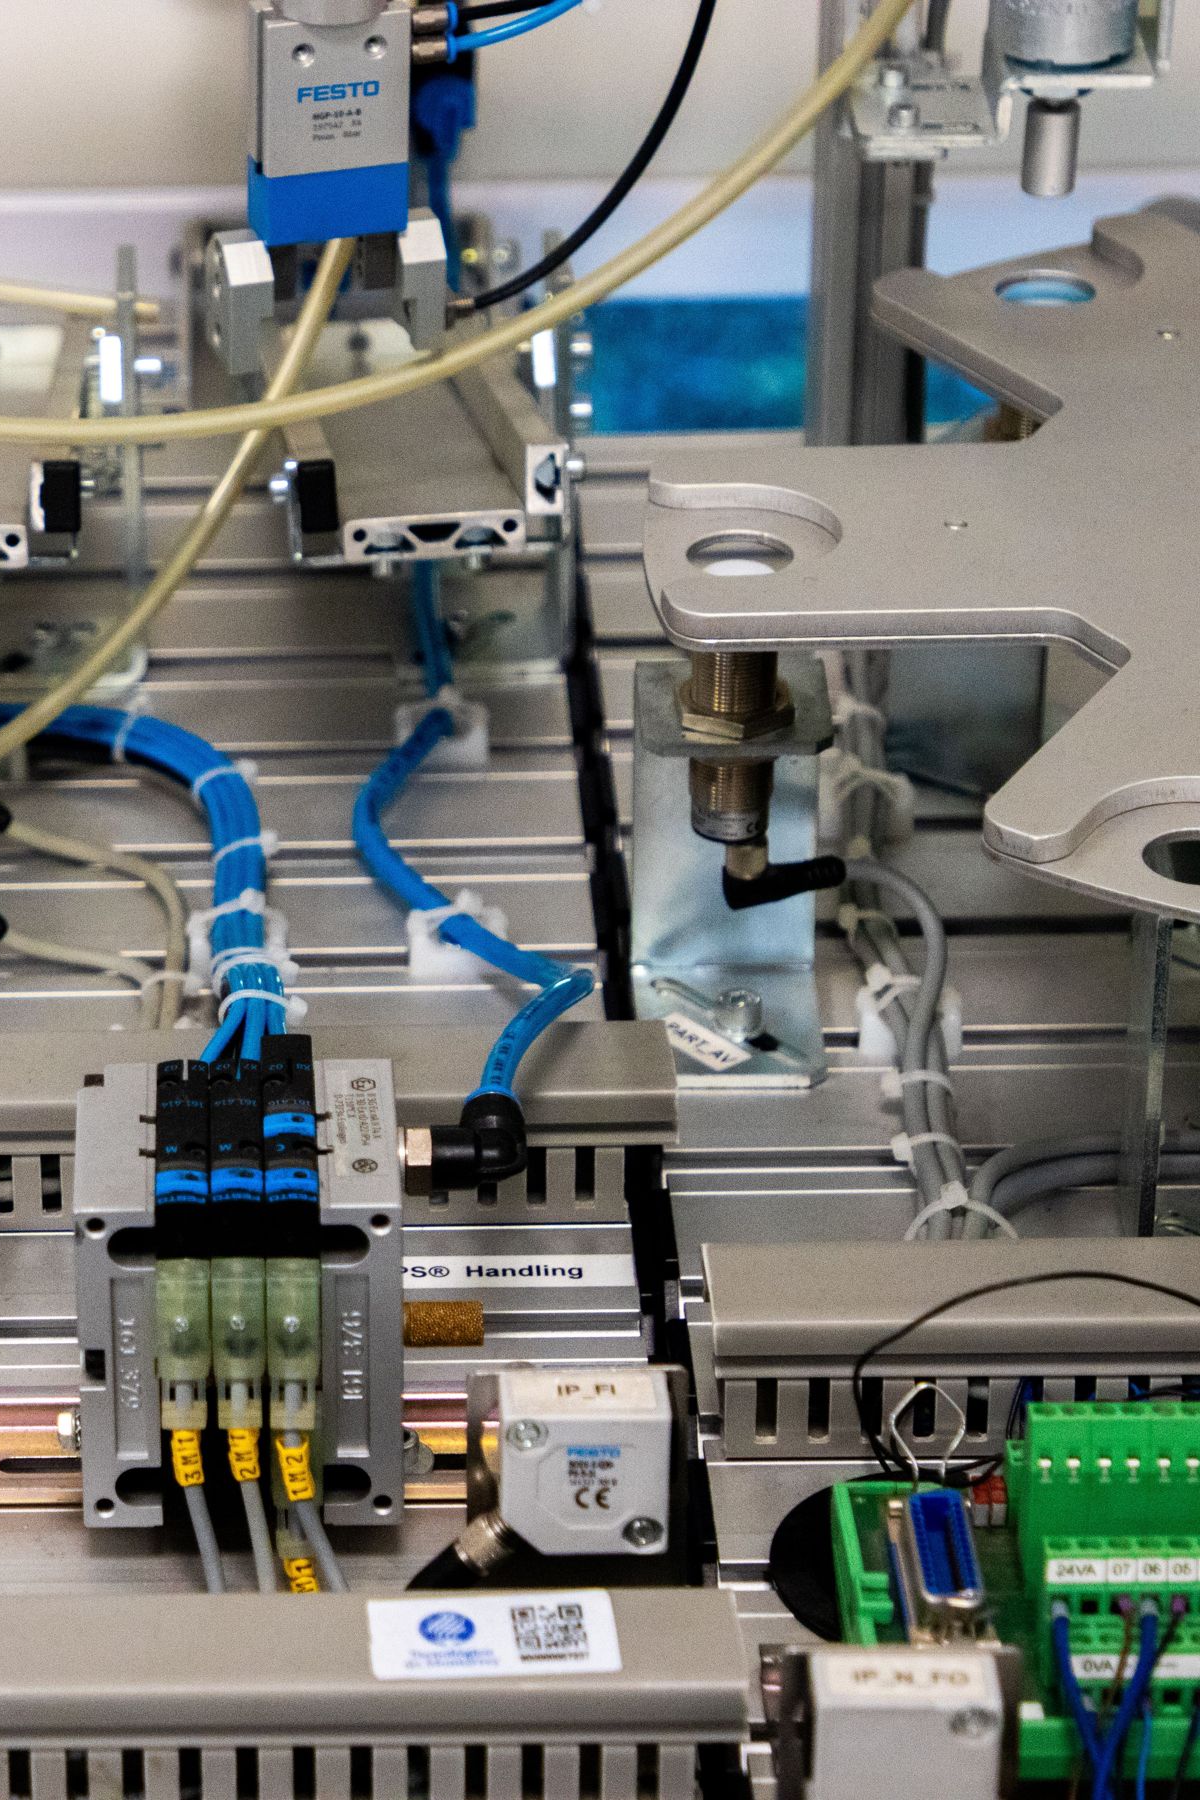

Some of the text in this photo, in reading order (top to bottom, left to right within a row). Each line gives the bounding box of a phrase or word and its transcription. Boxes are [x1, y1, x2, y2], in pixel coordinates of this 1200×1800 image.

[297, 80, 379, 103] FESTO
[667, 1021, 738, 1063] PART_AV
[466, 1264, 583, 1280] Handling
[1112, 1563, 1131, 1576] 07
